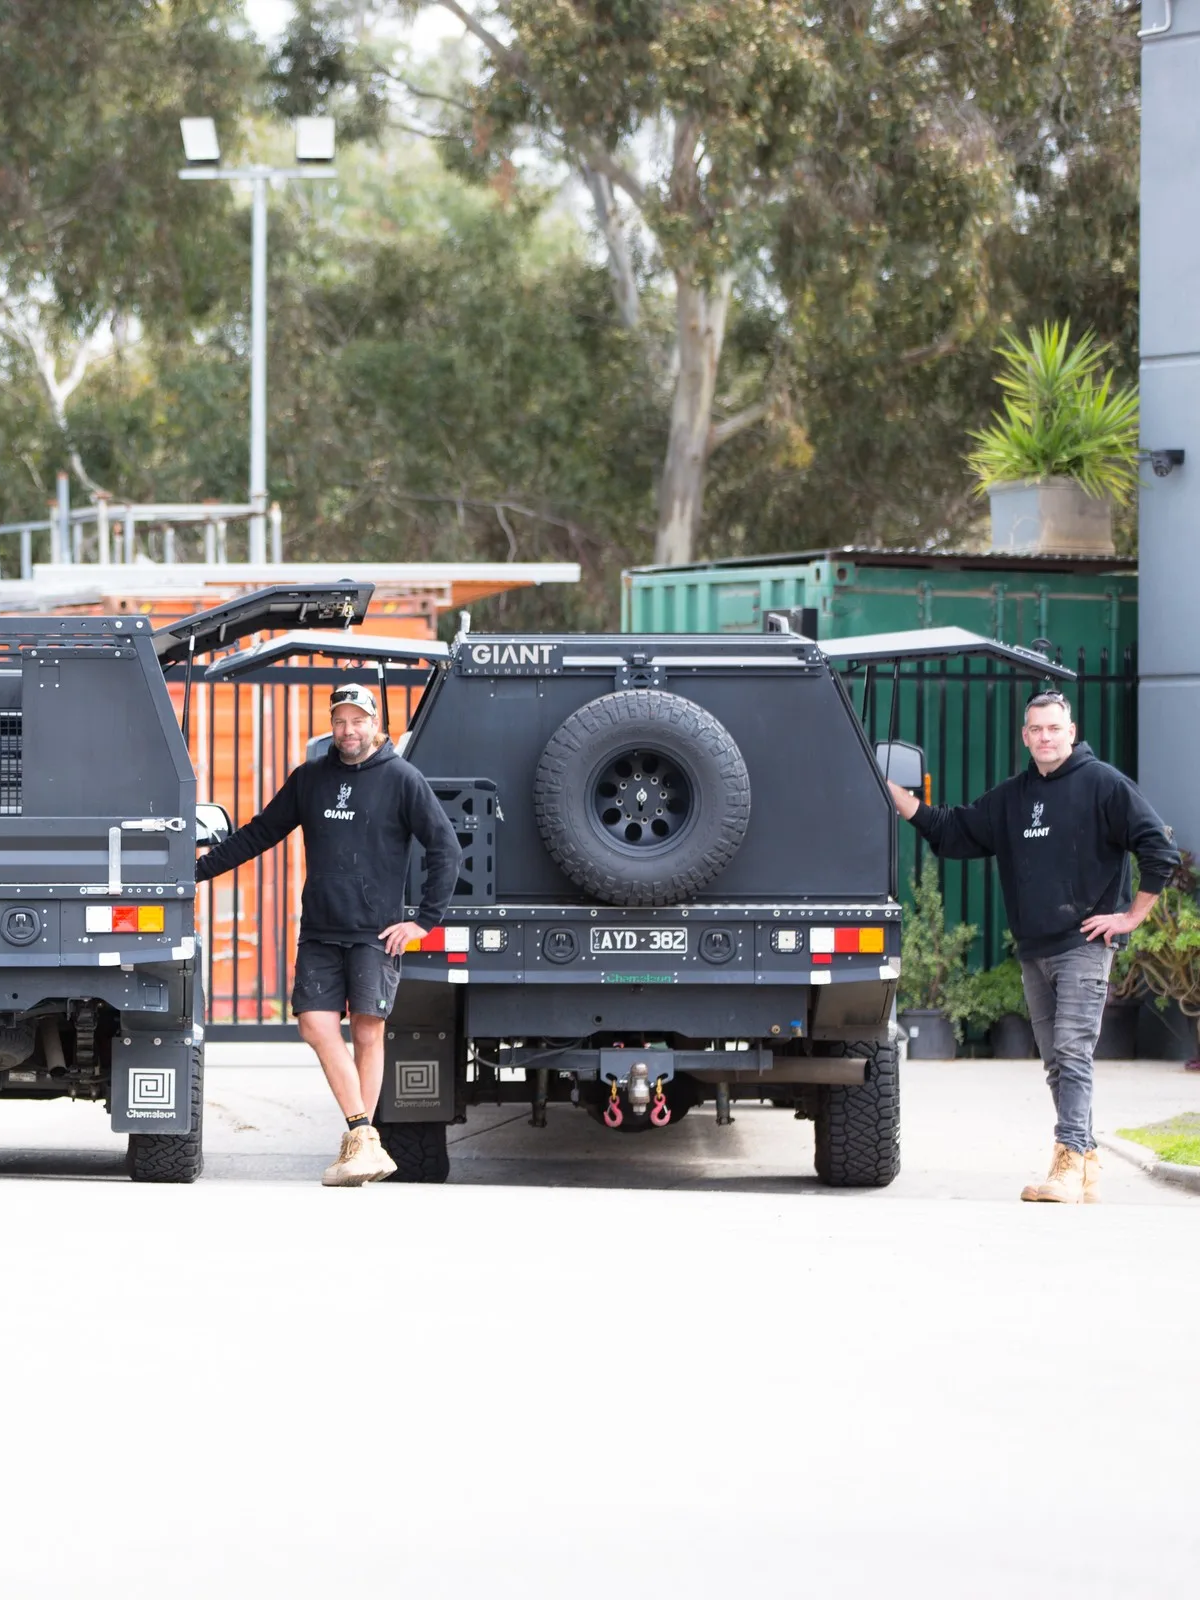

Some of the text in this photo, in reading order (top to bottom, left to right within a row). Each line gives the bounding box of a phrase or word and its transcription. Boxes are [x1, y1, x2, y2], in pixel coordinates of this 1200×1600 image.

[472, 644, 553, 664] GIANT
[324, 809, 355, 820] GIANT
[1023, 827, 1049, 838] GIANT
[126, 1109, 176, 1118] Chameleon
